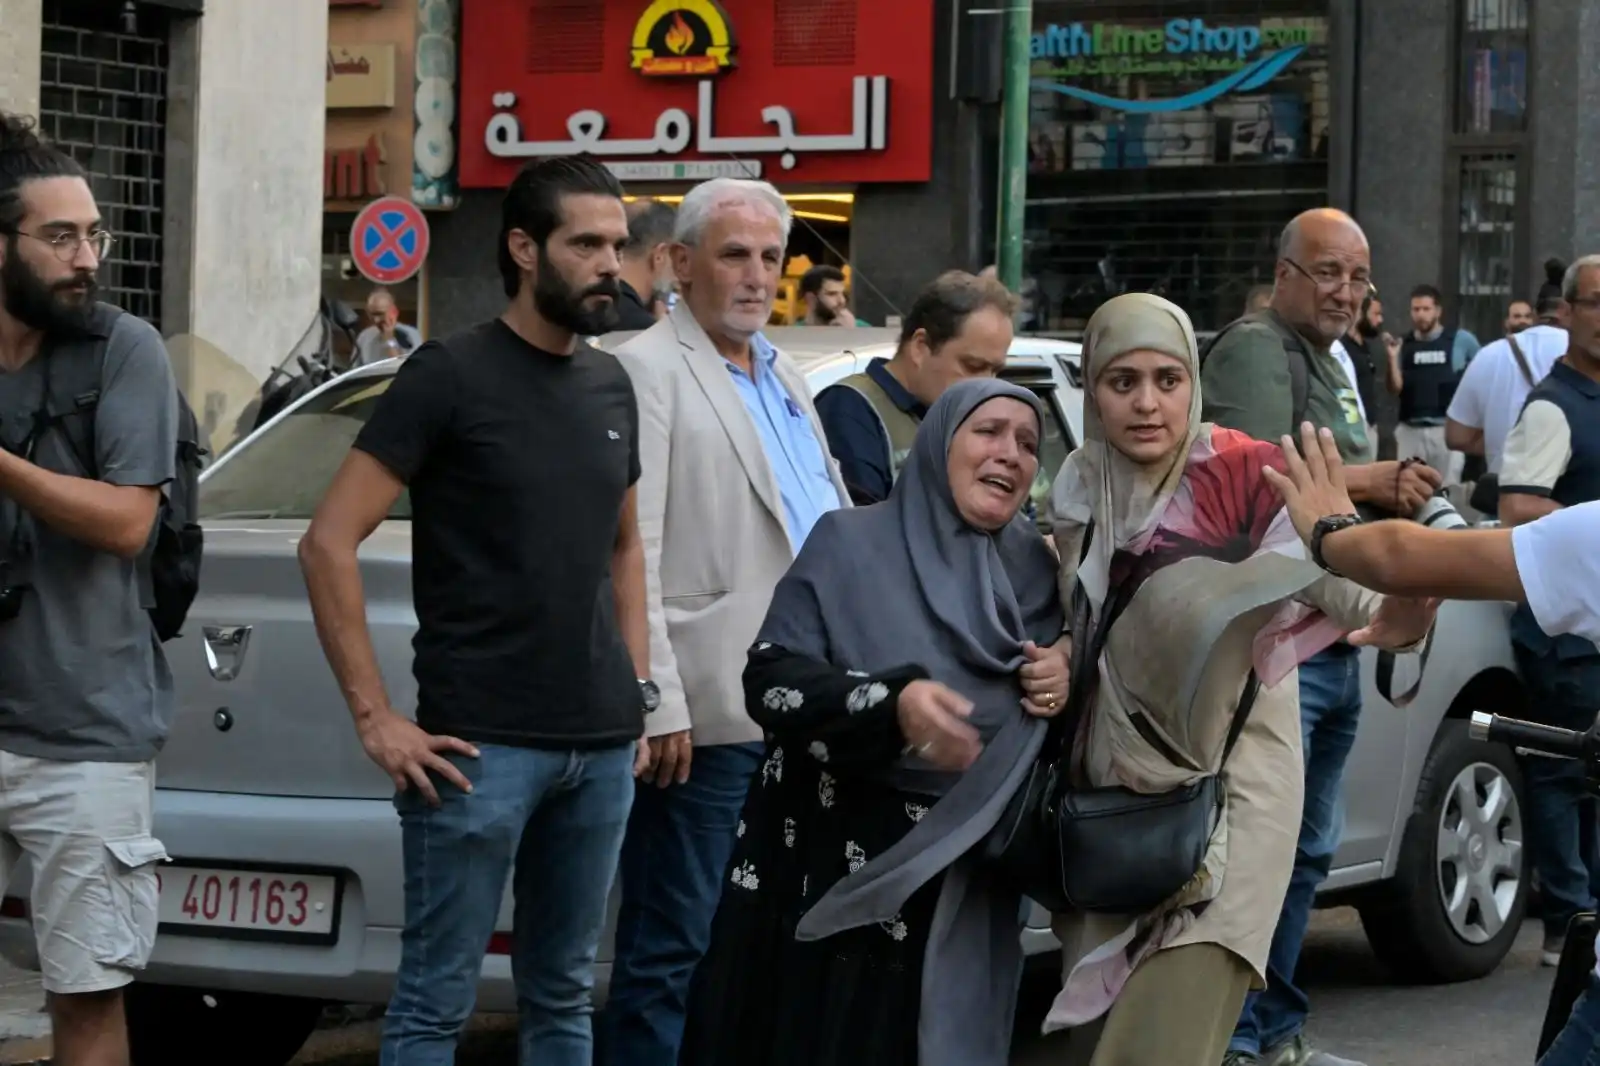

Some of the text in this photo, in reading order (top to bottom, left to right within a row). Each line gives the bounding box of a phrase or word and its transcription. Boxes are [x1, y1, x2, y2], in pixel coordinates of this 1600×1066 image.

[1030, 17, 1314, 60] althLineShop.com
[485, 75, 887, 170] الجامعة
[181, 873, 309, 926] 401163
